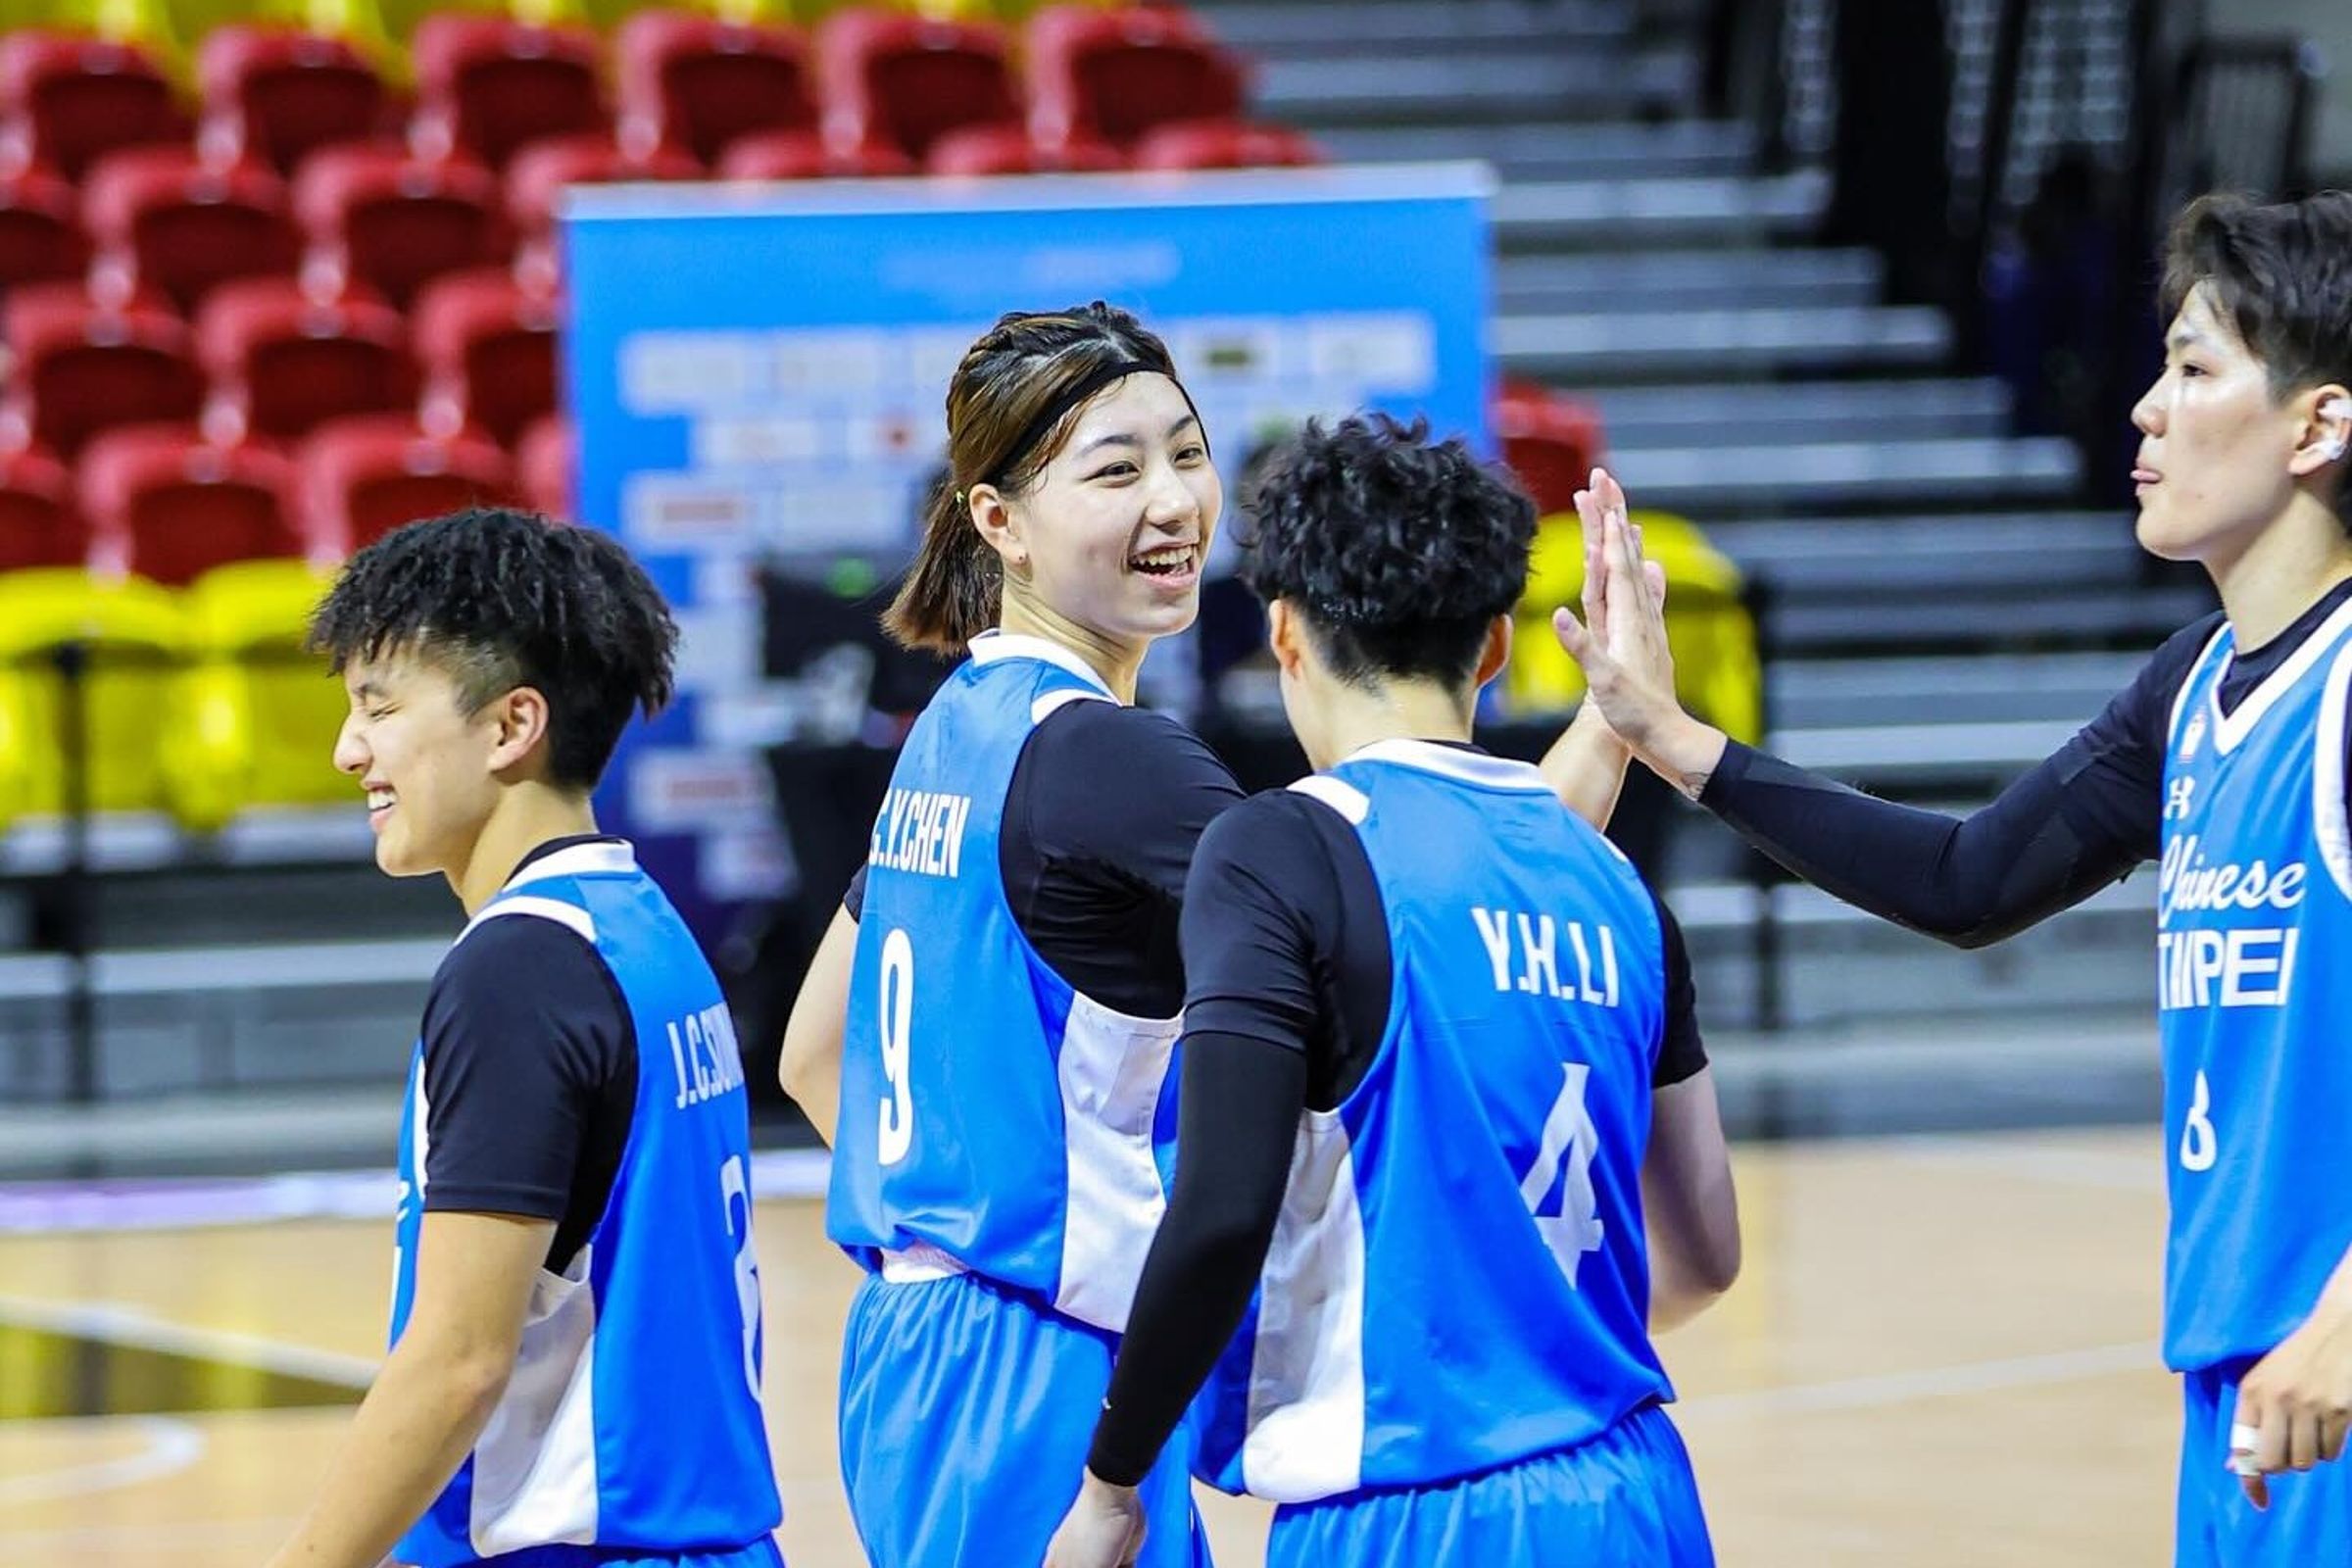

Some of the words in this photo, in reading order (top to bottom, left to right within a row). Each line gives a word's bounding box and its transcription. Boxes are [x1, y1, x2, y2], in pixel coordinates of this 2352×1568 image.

[879, 928, 914, 1166] 9
[1472, 907, 1620, 1008] Y.H.LI
[1519, 1061, 1604, 1292] 4
